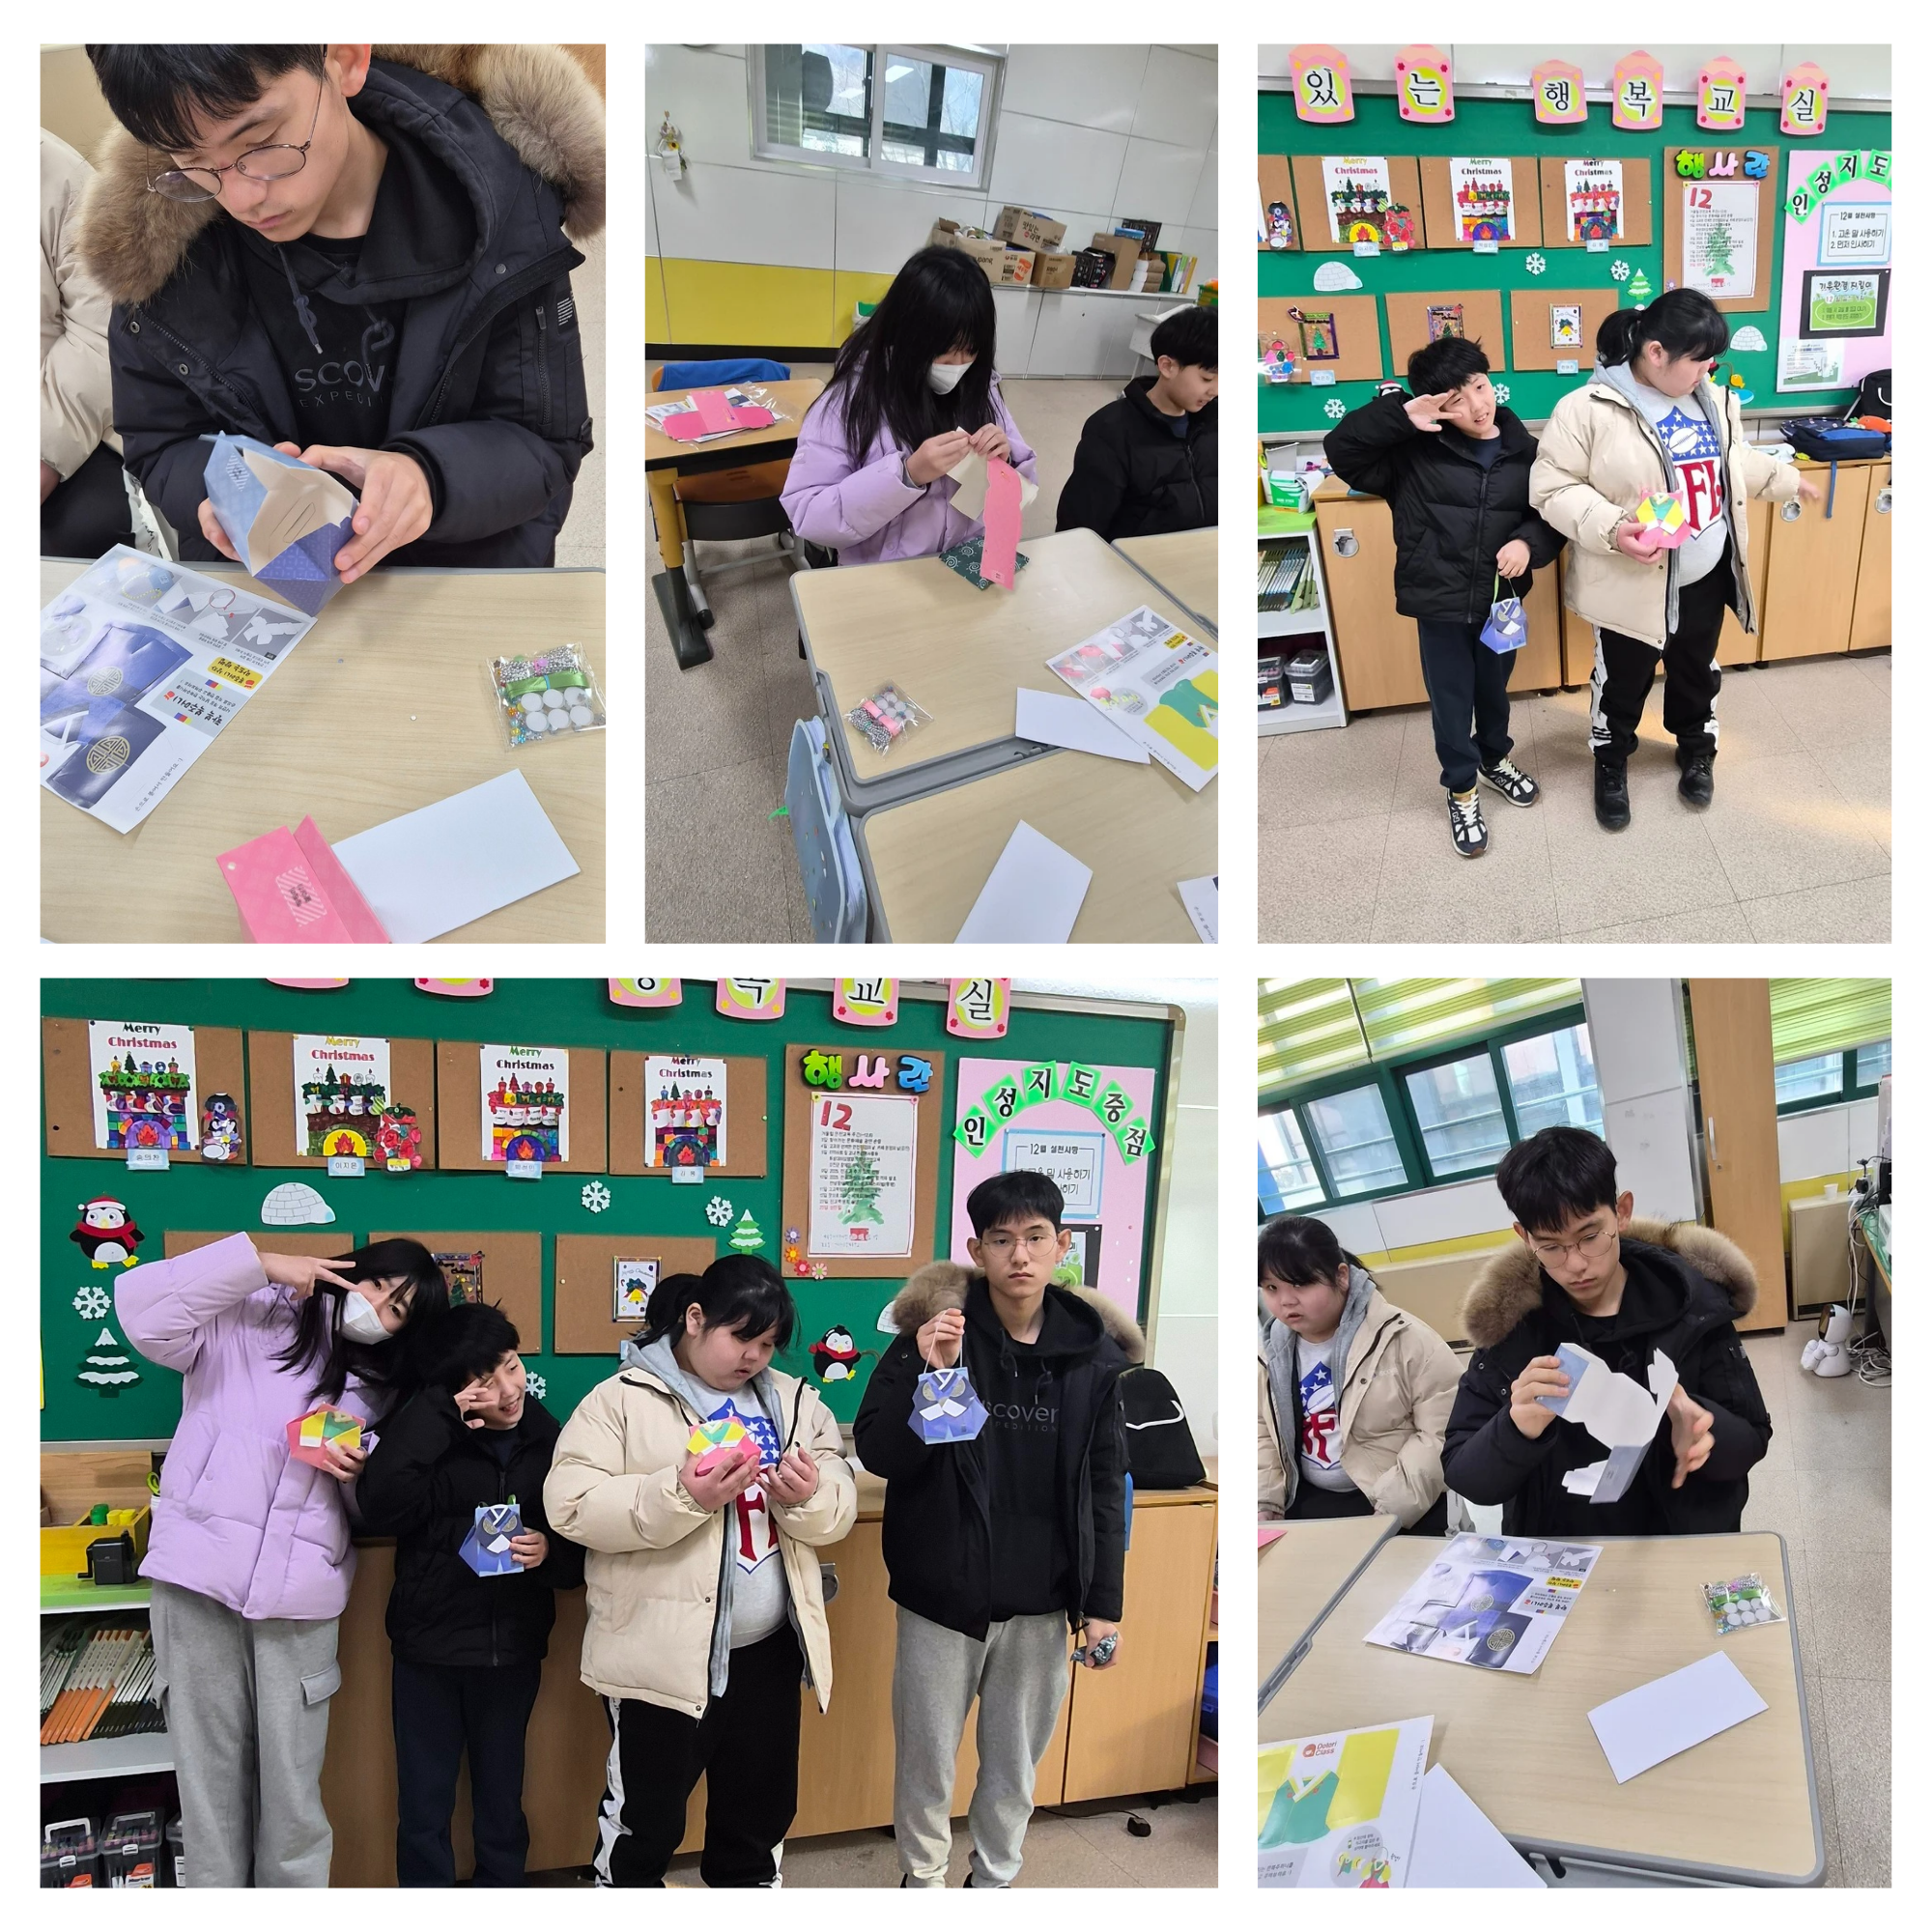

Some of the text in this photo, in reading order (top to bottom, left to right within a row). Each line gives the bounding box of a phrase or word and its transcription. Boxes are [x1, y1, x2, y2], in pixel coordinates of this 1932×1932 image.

[1690, 187, 1713, 209] 12
[172, 696, 206, 716] 복주머니
[123, 1022, 160, 1036] Merry
[108, 1037, 178, 1049] Christmas
[326, 1036, 360, 1048] Merry
[311, 1049, 375, 1062] Christmas
[509, 1045, 542, 1058] Merry
[496, 1059, 554, 1070] Christmas
[659, 1067, 713, 1078] Christmas
[820, 1099, 853, 1131] 12
[1030, 1144, 1047, 1154] 12월
[1057, 1167, 1091, 1180] 사용하기
[1315, 1747, 1334, 1756] Class
[1317, 1742, 1337, 1750] Dotori
